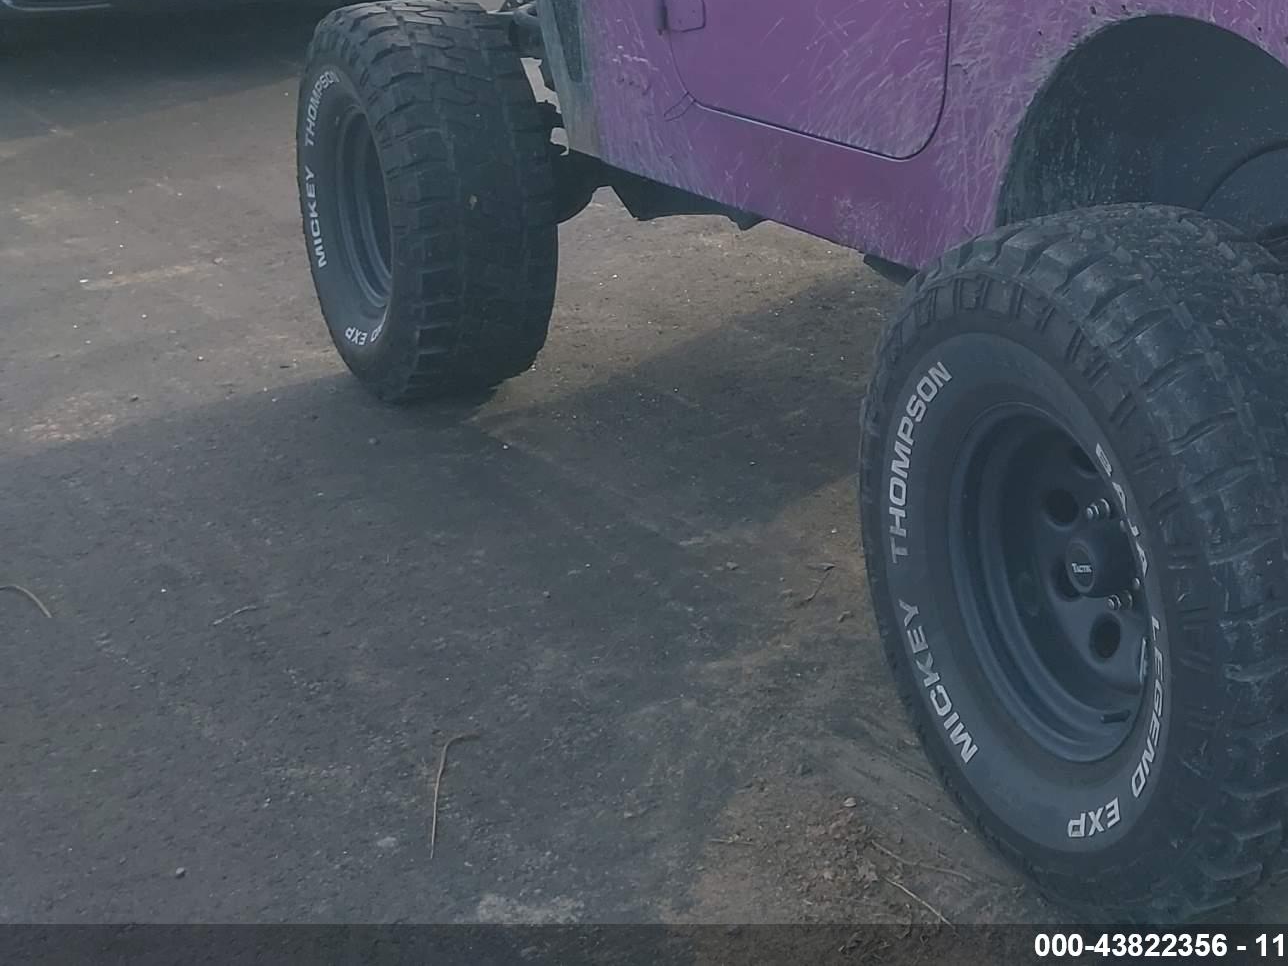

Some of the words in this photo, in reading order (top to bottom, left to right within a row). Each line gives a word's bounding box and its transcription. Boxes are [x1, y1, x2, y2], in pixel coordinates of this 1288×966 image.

[304, 70, 340, 146] THOMPSON
[304, 164, 328, 269] MICKEY
[344, 327, 368, 346] EXP
[888, 361, 953, 564] THOMPSON
[898, 598, 979, 764] MICKEY
[1131, 615, 1164, 798] LEGEND
[1067, 797, 1121, 838] EXP
